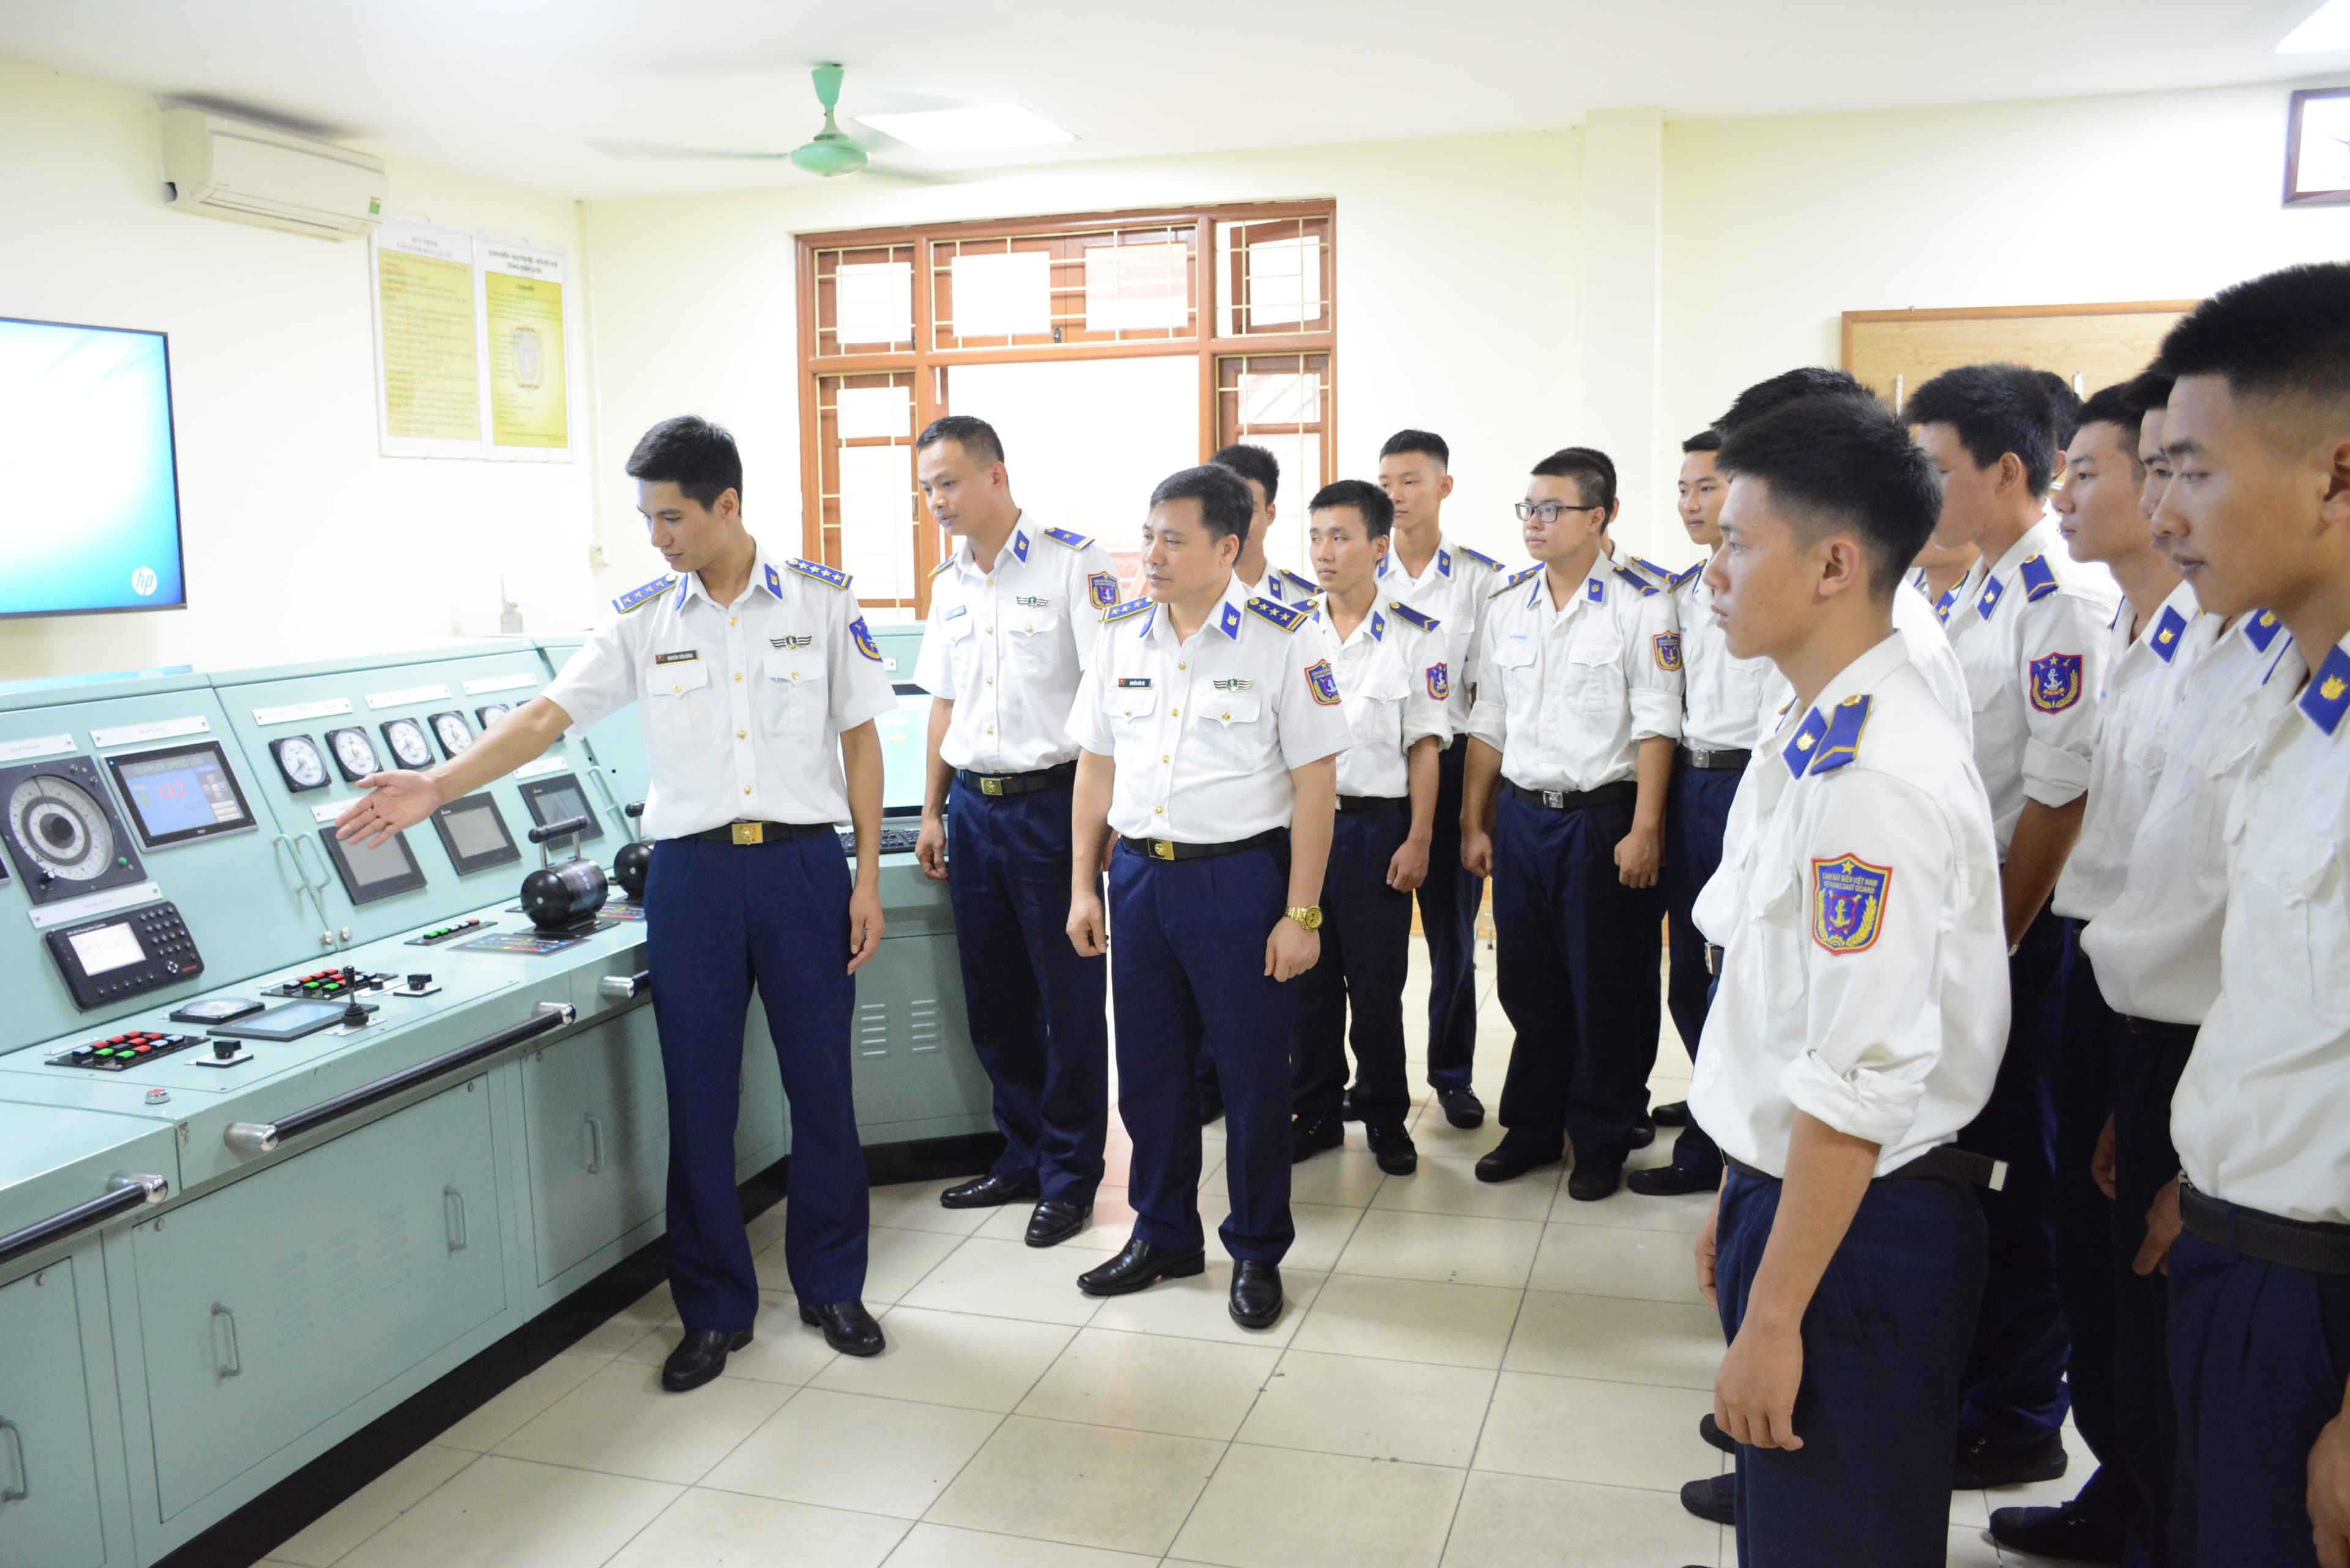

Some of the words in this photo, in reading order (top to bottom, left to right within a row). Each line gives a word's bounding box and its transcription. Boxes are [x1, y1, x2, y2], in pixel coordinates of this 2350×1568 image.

[134, 567, 155, 595] hp
[135, 764, 165, 775] DOPPLER
[166, 760, 189, 769] SPEED
[190, 756, 205, 766] LOG
[1855, 885, 1874, 894] GUARD
[1865, 878, 1878, 887] NAM
